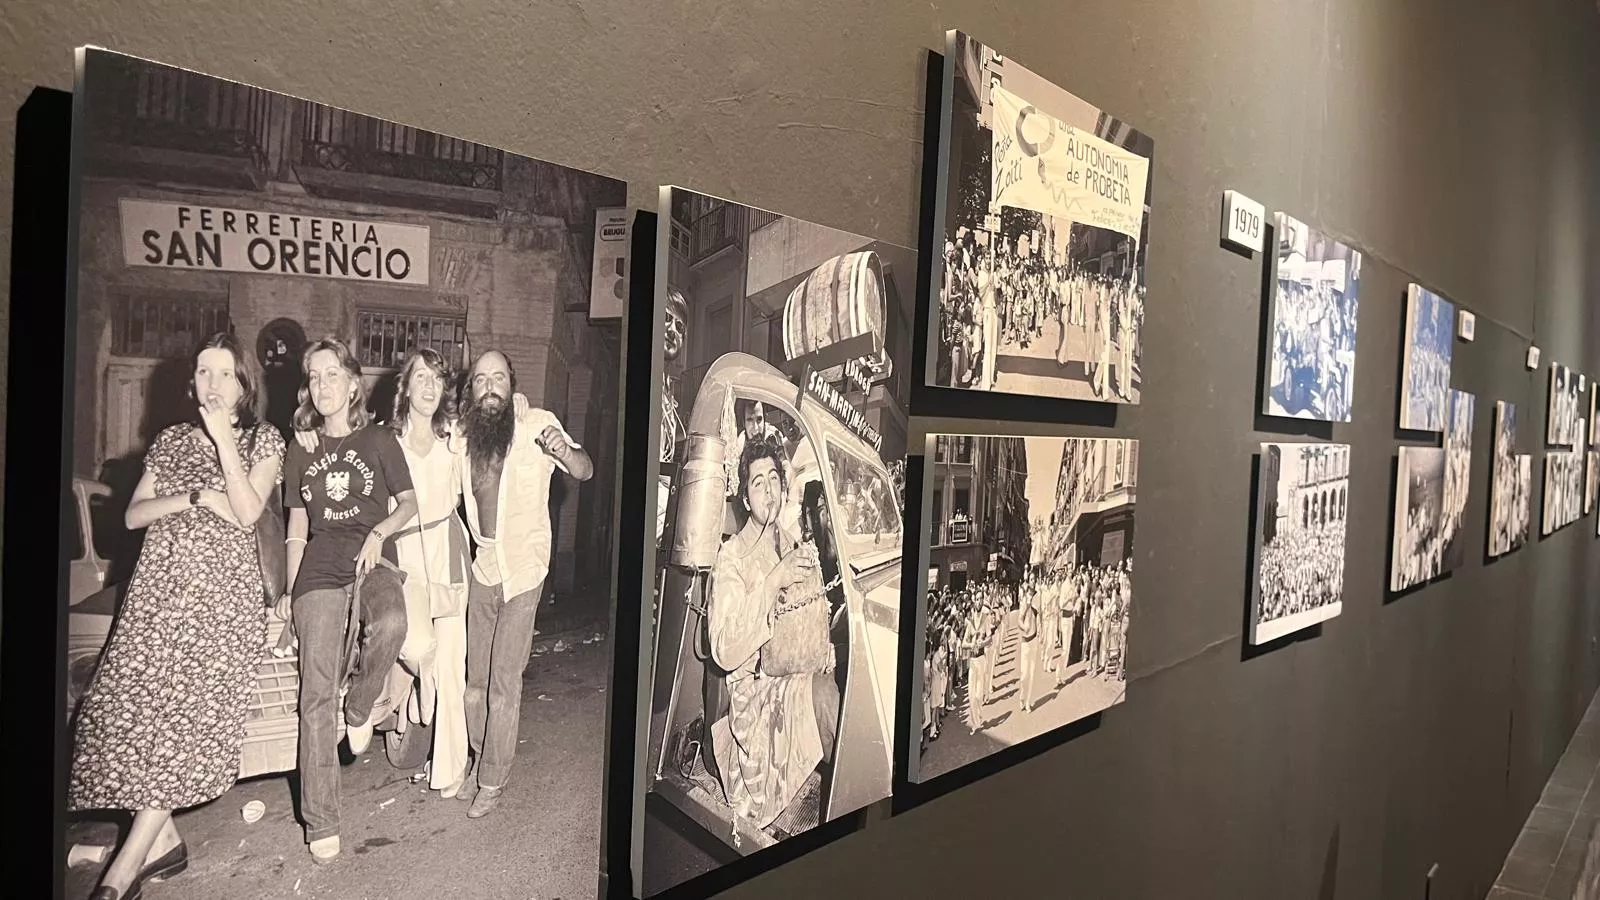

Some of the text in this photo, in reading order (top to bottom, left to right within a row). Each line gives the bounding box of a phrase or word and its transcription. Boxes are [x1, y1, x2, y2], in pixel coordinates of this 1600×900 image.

[1066, 138, 1130, 184] AUTONOMIA
[1066, 162, 1132, 207] de PROBETA
[178, 206, 379, 245] FERRETERIA
[1234, 207, 1259, 239] 1979
[142, 229, 411, 281] SAN ORENCIO
[323, 505, 360, 521] Huesca
